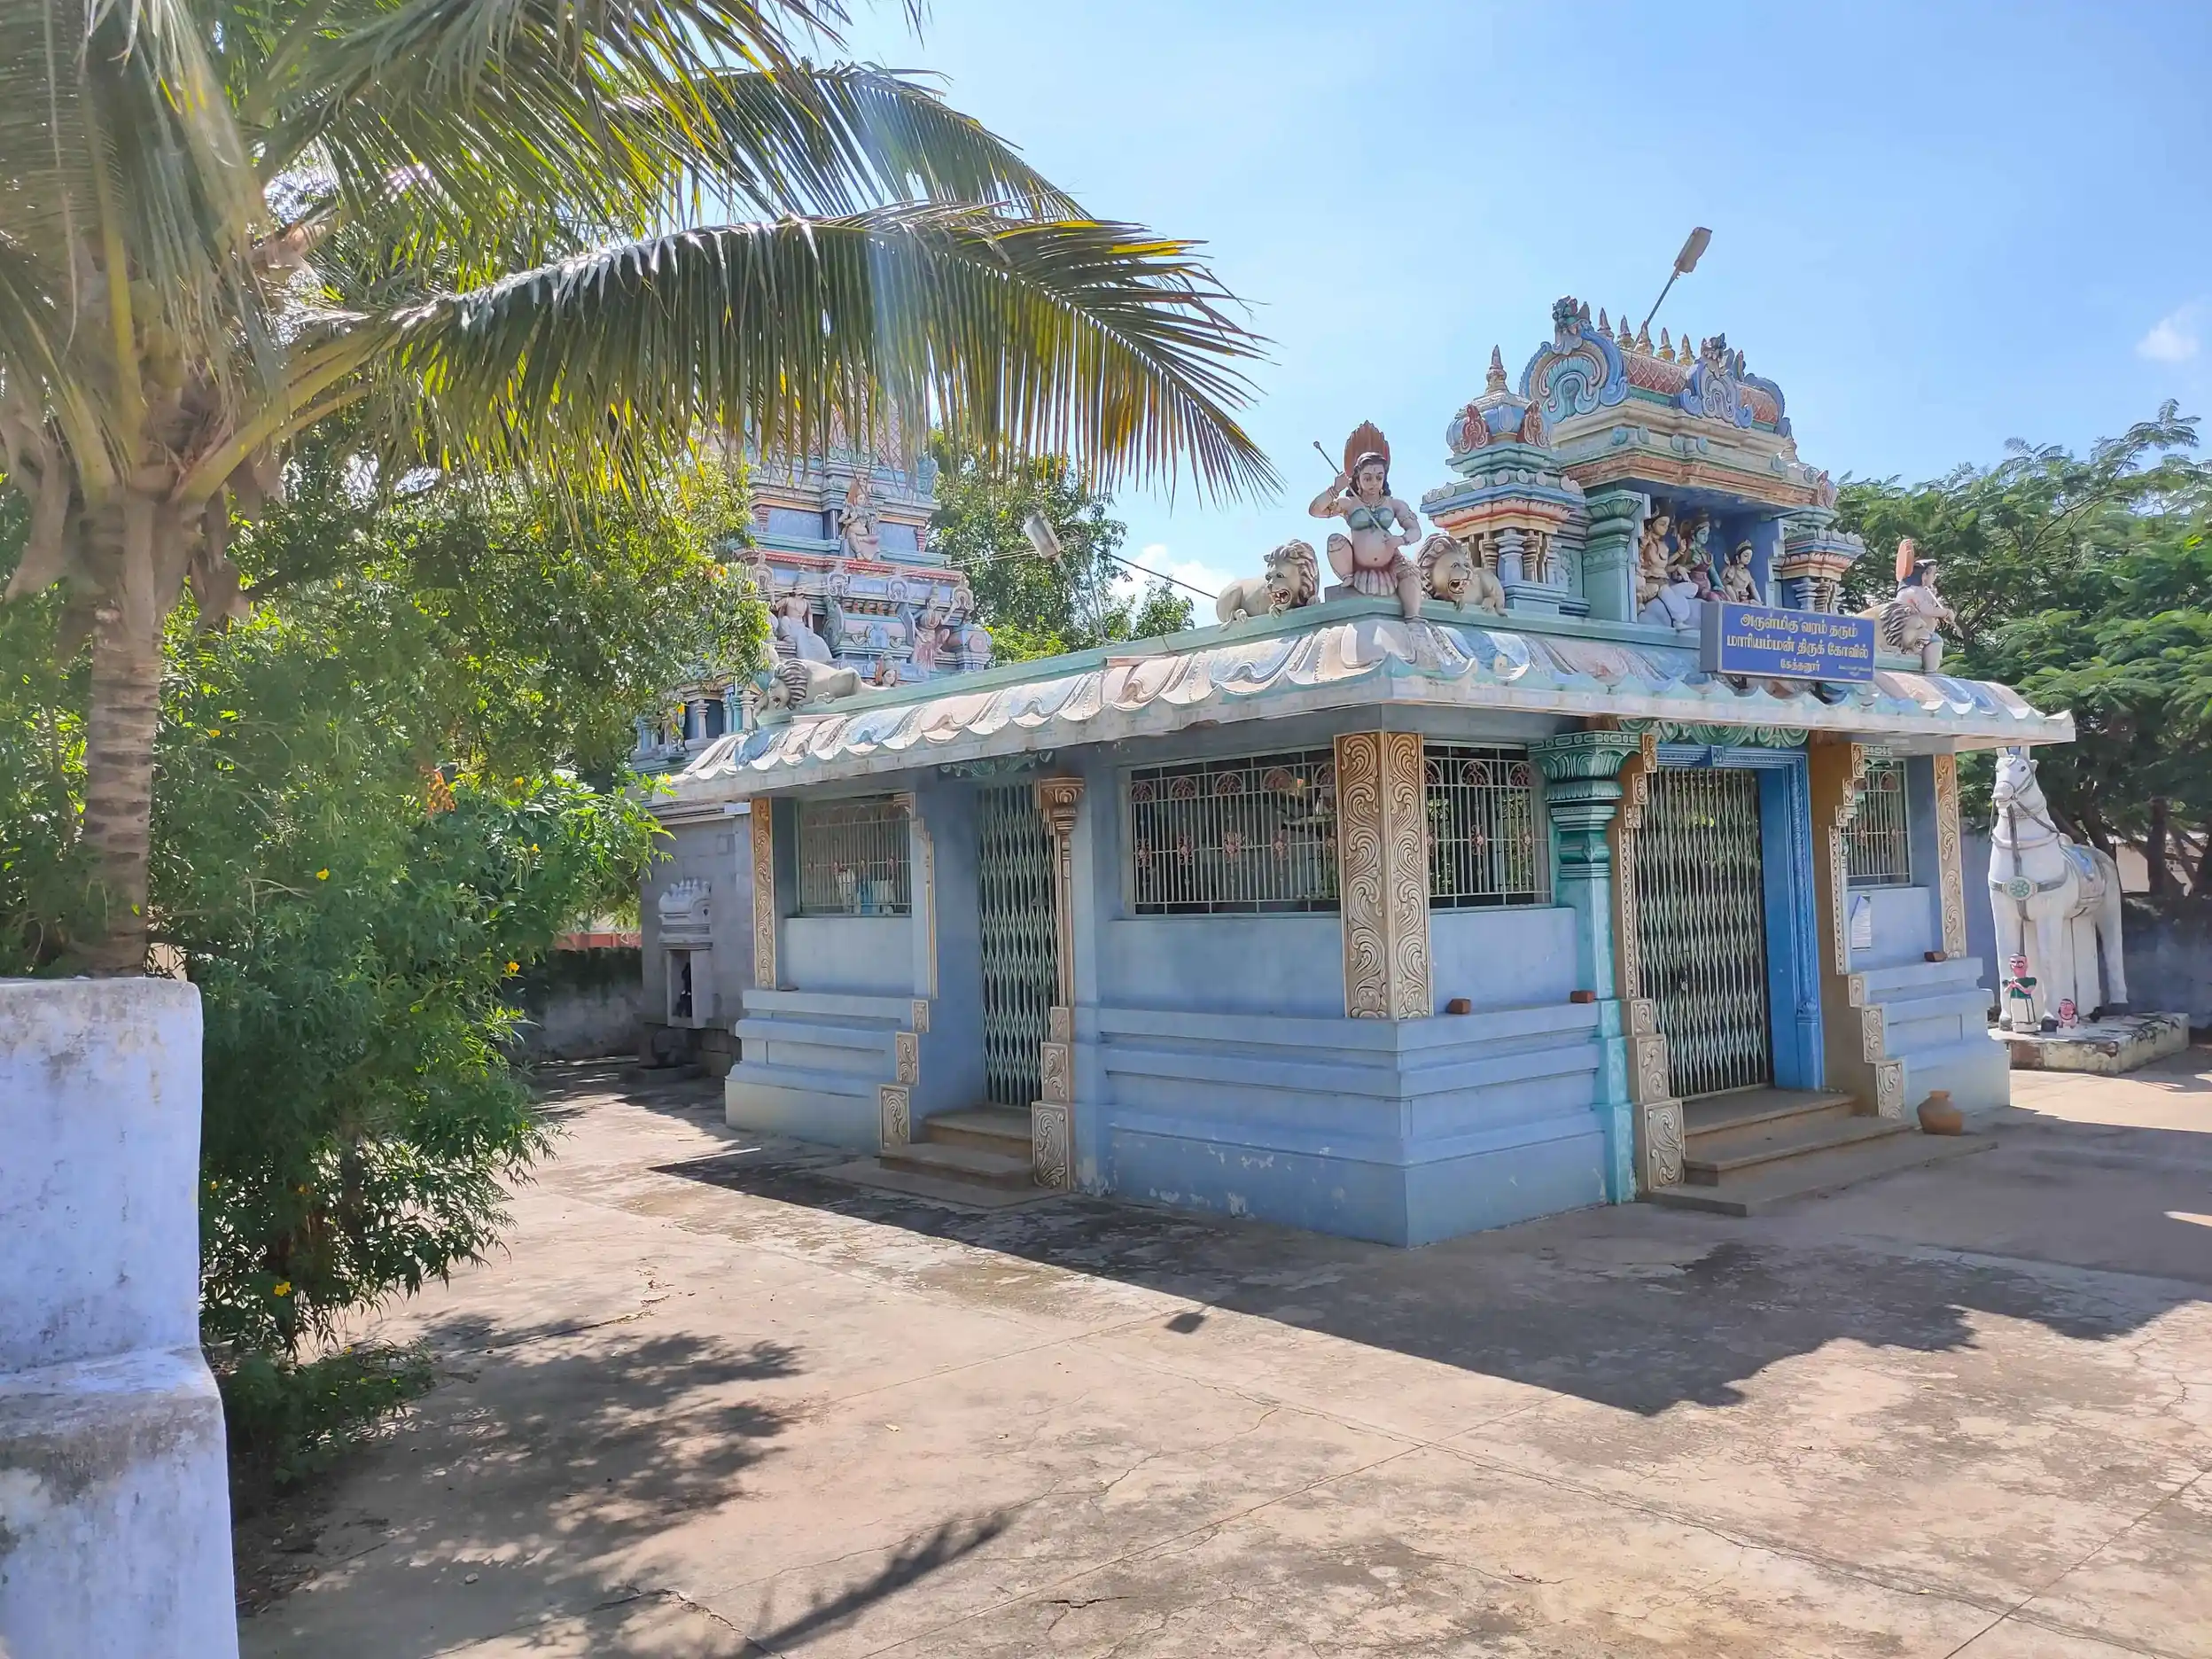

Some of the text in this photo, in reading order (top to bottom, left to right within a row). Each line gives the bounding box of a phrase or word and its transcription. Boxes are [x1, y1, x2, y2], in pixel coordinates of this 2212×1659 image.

[1801, 619, 1827, 635] வரம்
[1828, 622, 1858, 639] தரும்
[1726, 632, 1869, 659] மாரியம்மன் திருக் கோவில்
